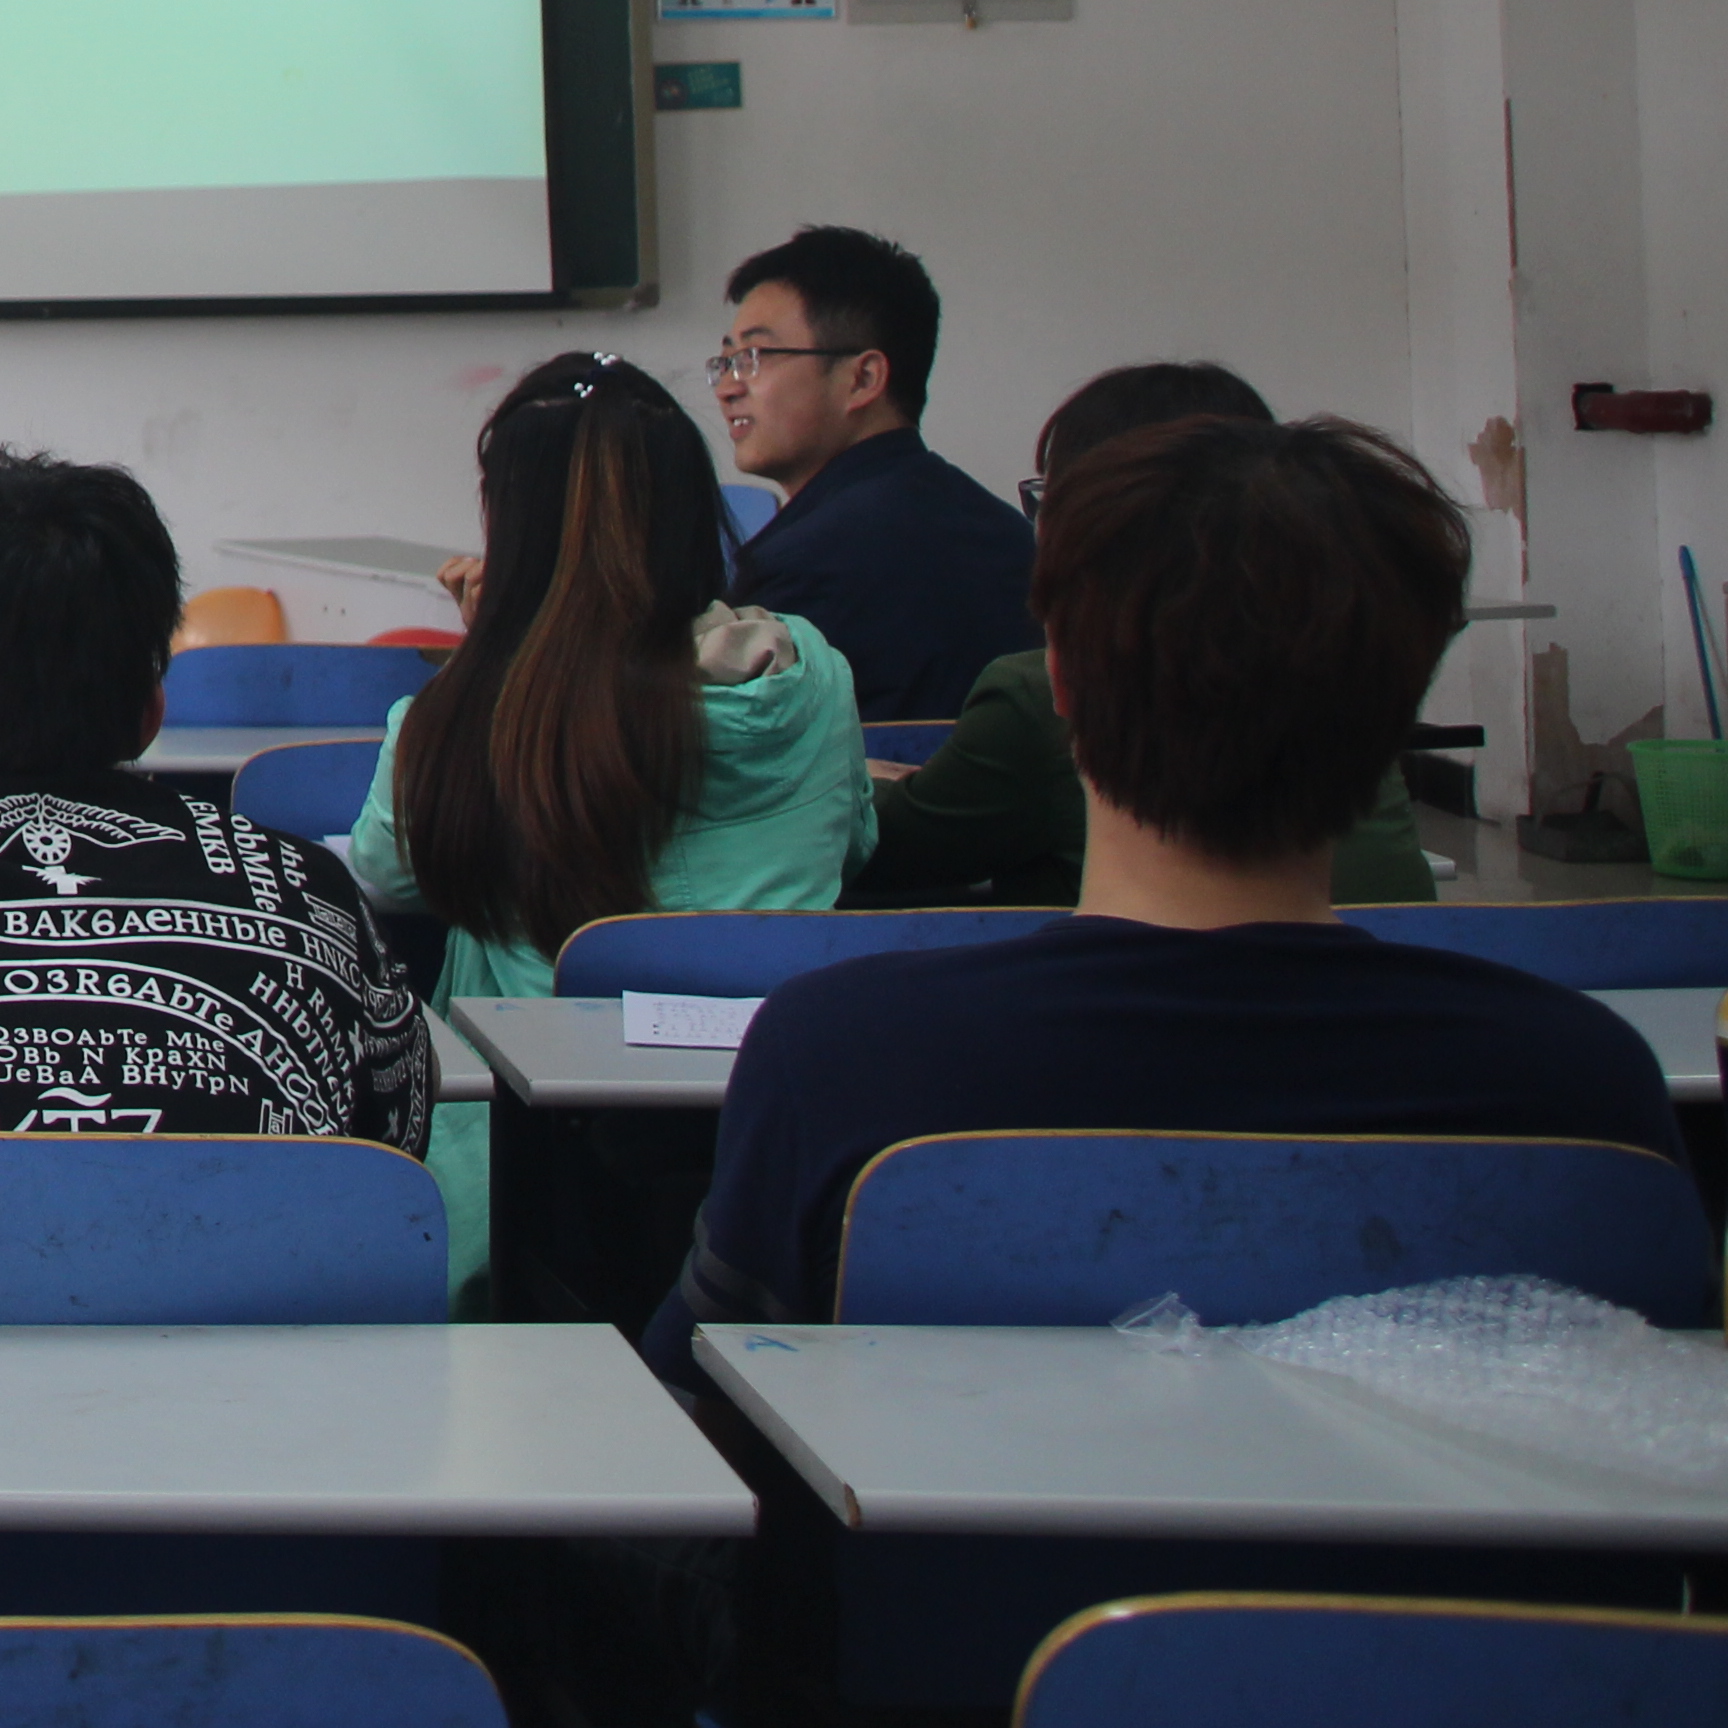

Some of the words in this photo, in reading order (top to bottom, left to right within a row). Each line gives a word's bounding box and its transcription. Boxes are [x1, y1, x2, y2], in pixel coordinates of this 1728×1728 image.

[179, 794, 236, 874] EMKB
[166, 1030, 225, 1054] Mhe
[82, 1047, 105, 1066] N
